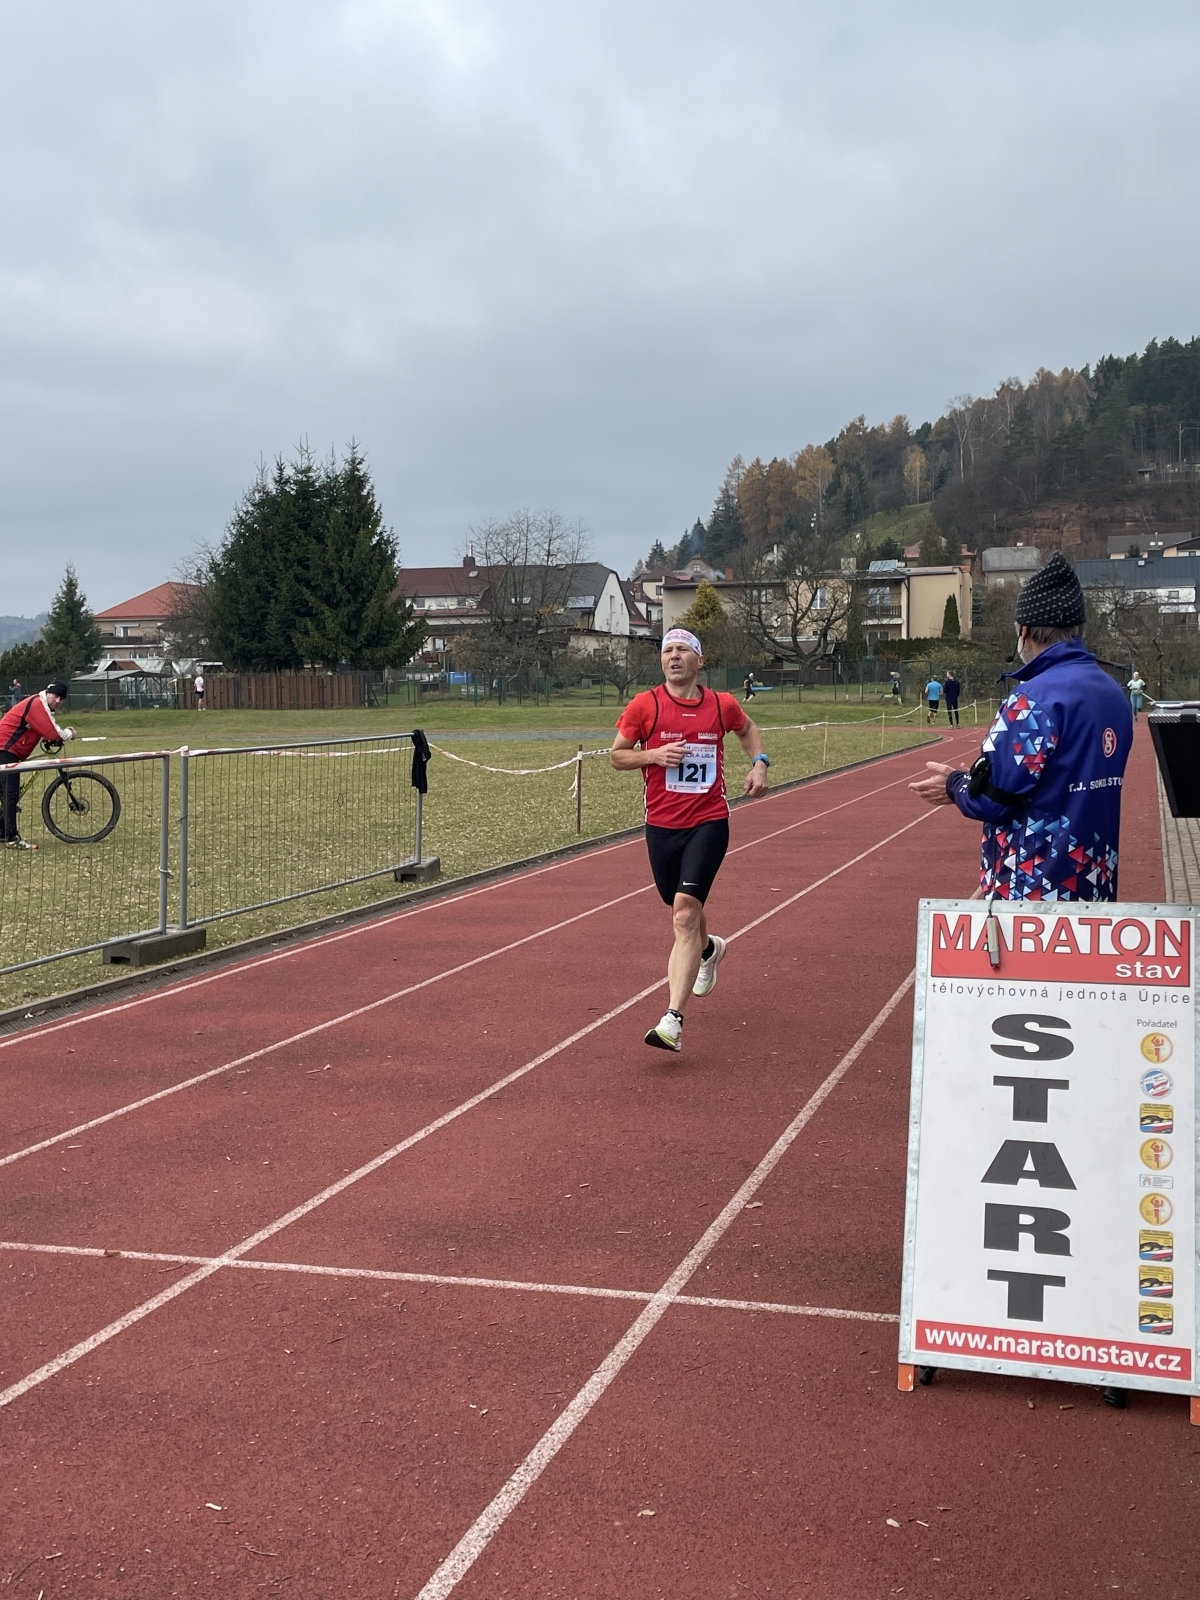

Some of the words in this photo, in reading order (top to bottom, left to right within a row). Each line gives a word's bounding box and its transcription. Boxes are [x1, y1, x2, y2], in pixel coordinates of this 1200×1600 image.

[678, 762, 707, 783] 121
[1068, 781, 1087, 792] T.J.
[932, 913, 1191, 957] MARATON
[1115, 960, 1182, 979] stav
[932, 982, 1049, 998] tělovýchovná
[1059, 987, 1127, 1001] jednota
[1138, 989, 1190, 1005] Úpice
[1136, 1018, 1178, 1028] Pořadatel
[980, 1013, 1077, 1322] START
[924, 1327, 1182, 1372] www.maratonstav.cz
